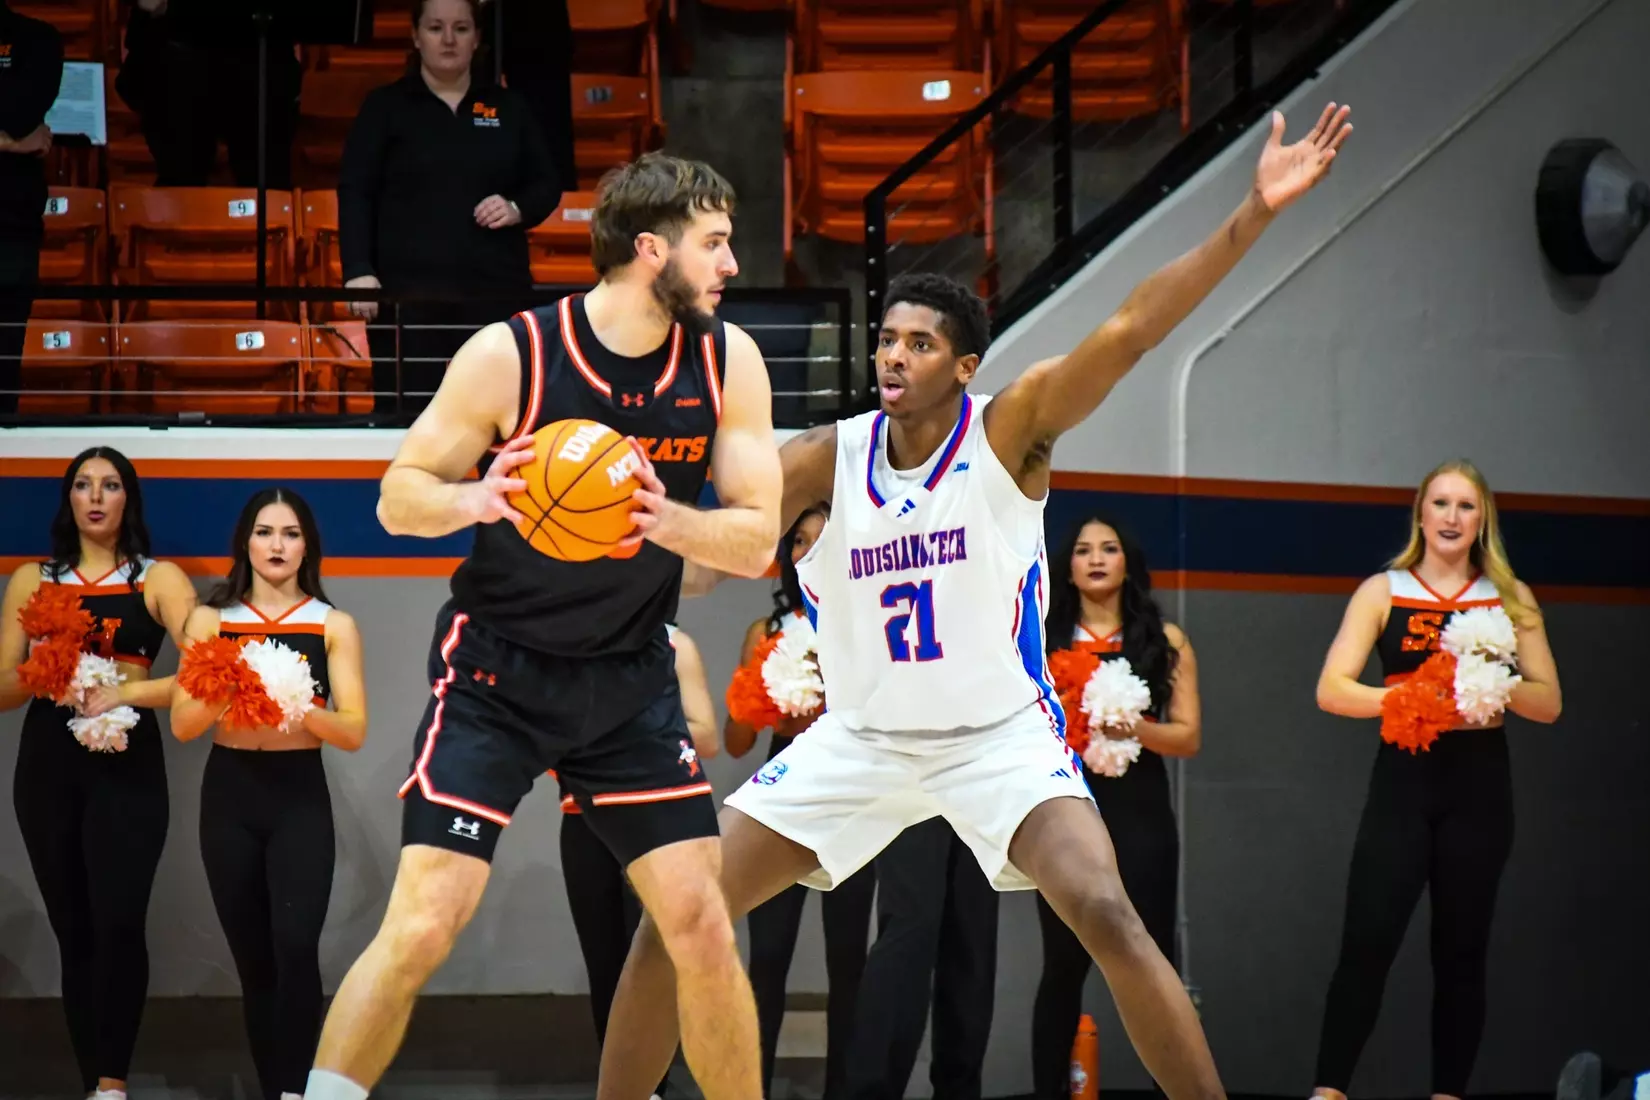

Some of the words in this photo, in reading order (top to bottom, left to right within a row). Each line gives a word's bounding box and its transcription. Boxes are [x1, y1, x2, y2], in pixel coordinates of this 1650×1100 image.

[50, 199, 58, 212] 8
[238, 202, 246, 215] 9
[53, 333, 61, 348] 5
[245, 333, 253, 348] 6
[849, 533, 929, 580] OUISIAN
[880, 579, 944, 662] 21
